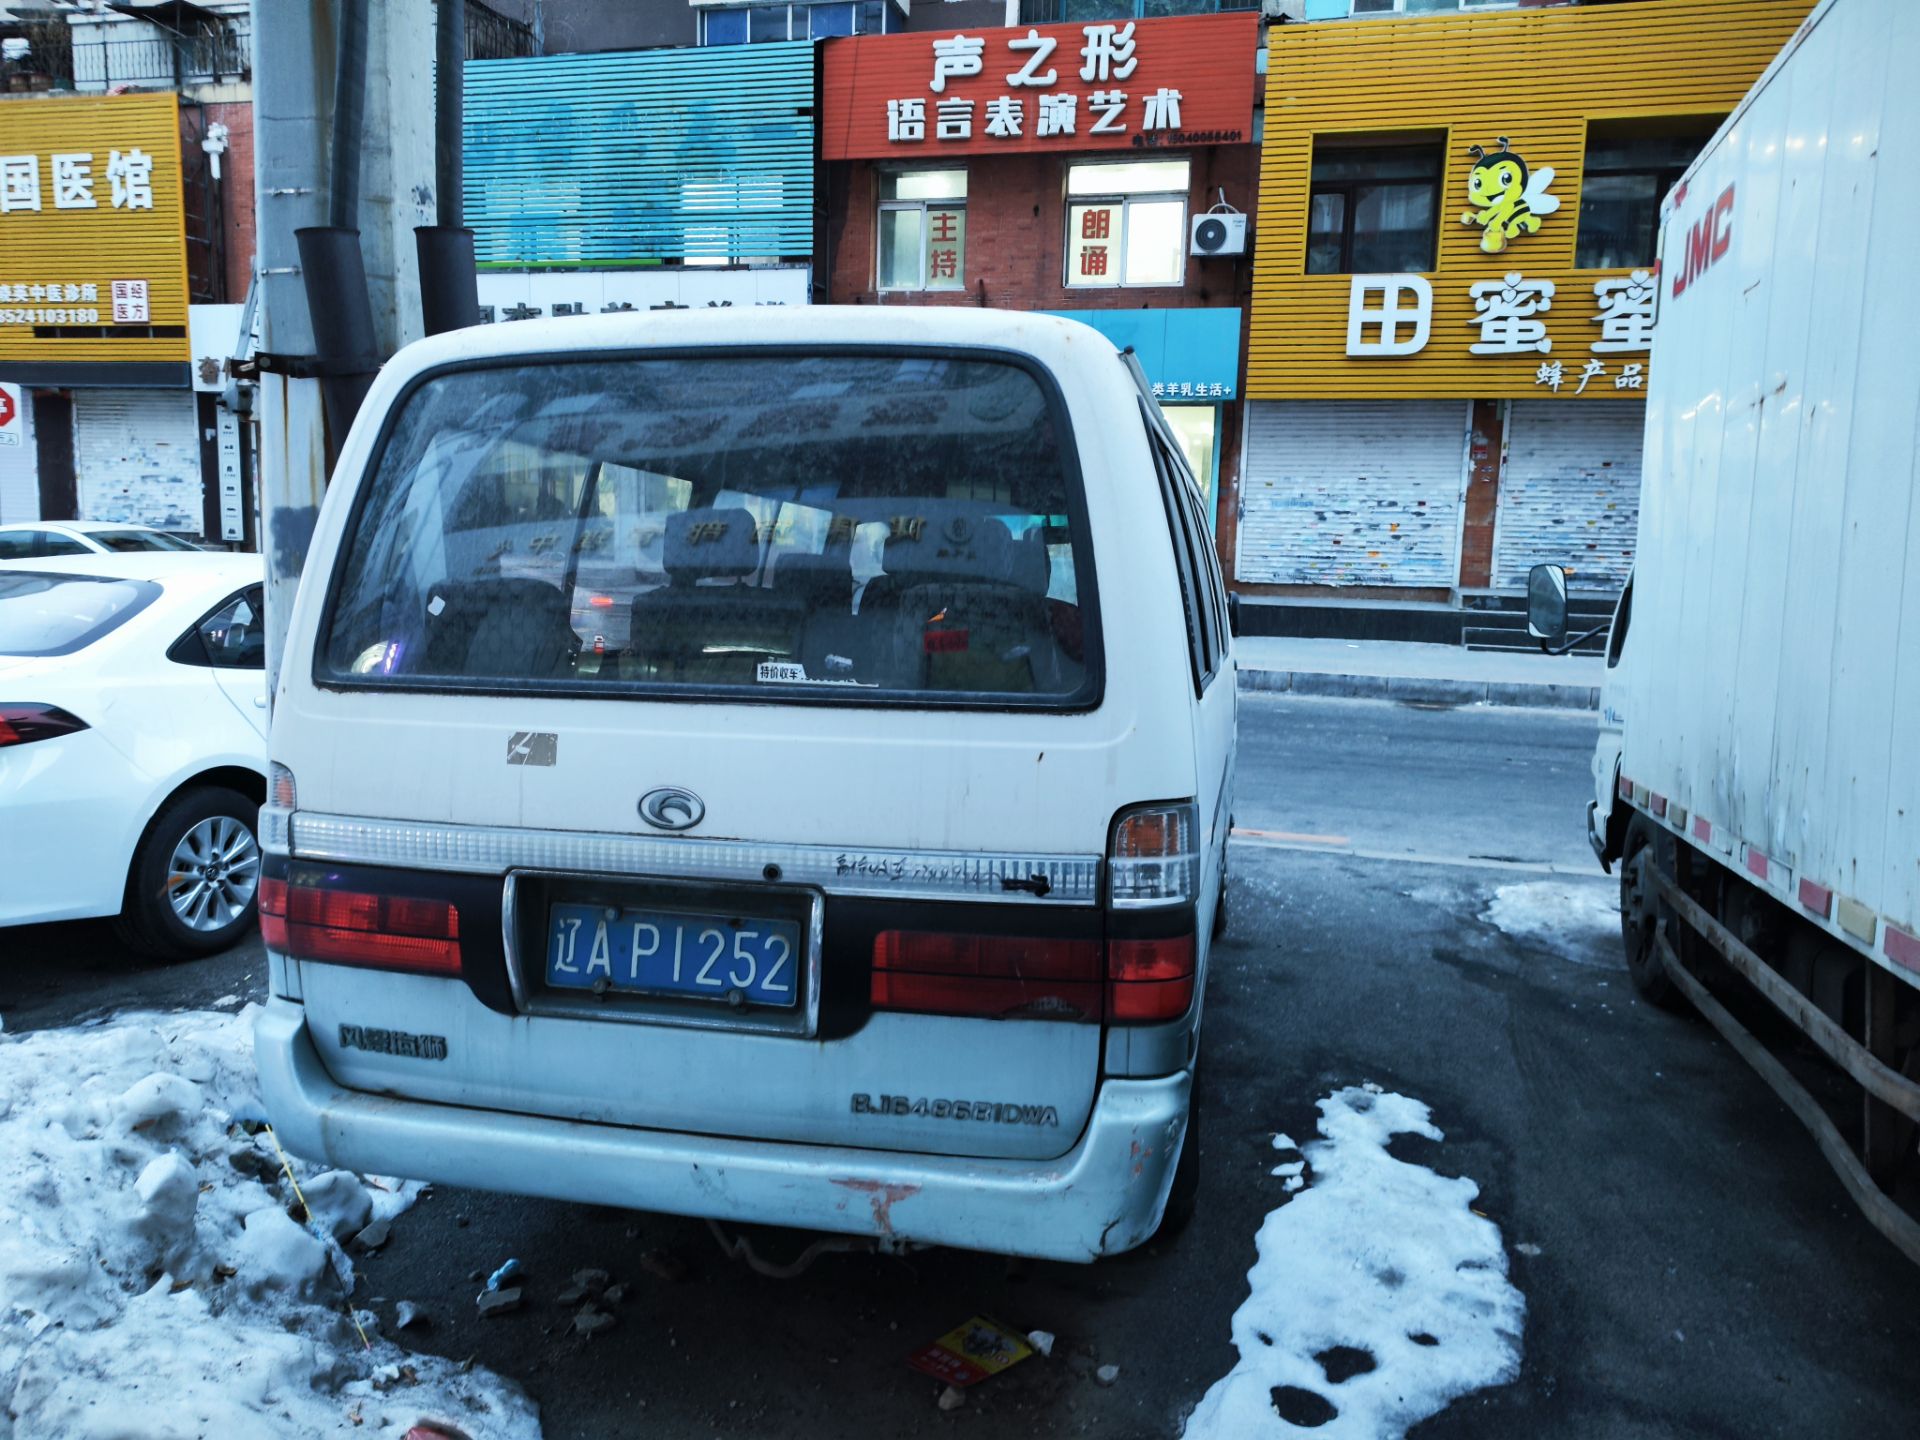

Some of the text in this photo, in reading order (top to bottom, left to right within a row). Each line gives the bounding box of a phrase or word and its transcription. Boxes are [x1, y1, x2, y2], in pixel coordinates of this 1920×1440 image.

[929, 21, 1138, 93] 声之形
[887, 87, 1183, 142] 语言表演艺术
[0, 149, 153, 213] 国医馆
[931, 212, 957, 279] 主持
[1080, 209, 1110, 277] 朗诵
[1673, 181, 1735, 300] JMC
[1346, 270, 1656, 358] 田蜜蜜
[1536, 359, 1643, 394] 蜂产品
[759, 665, 799, 680] 特价收车
